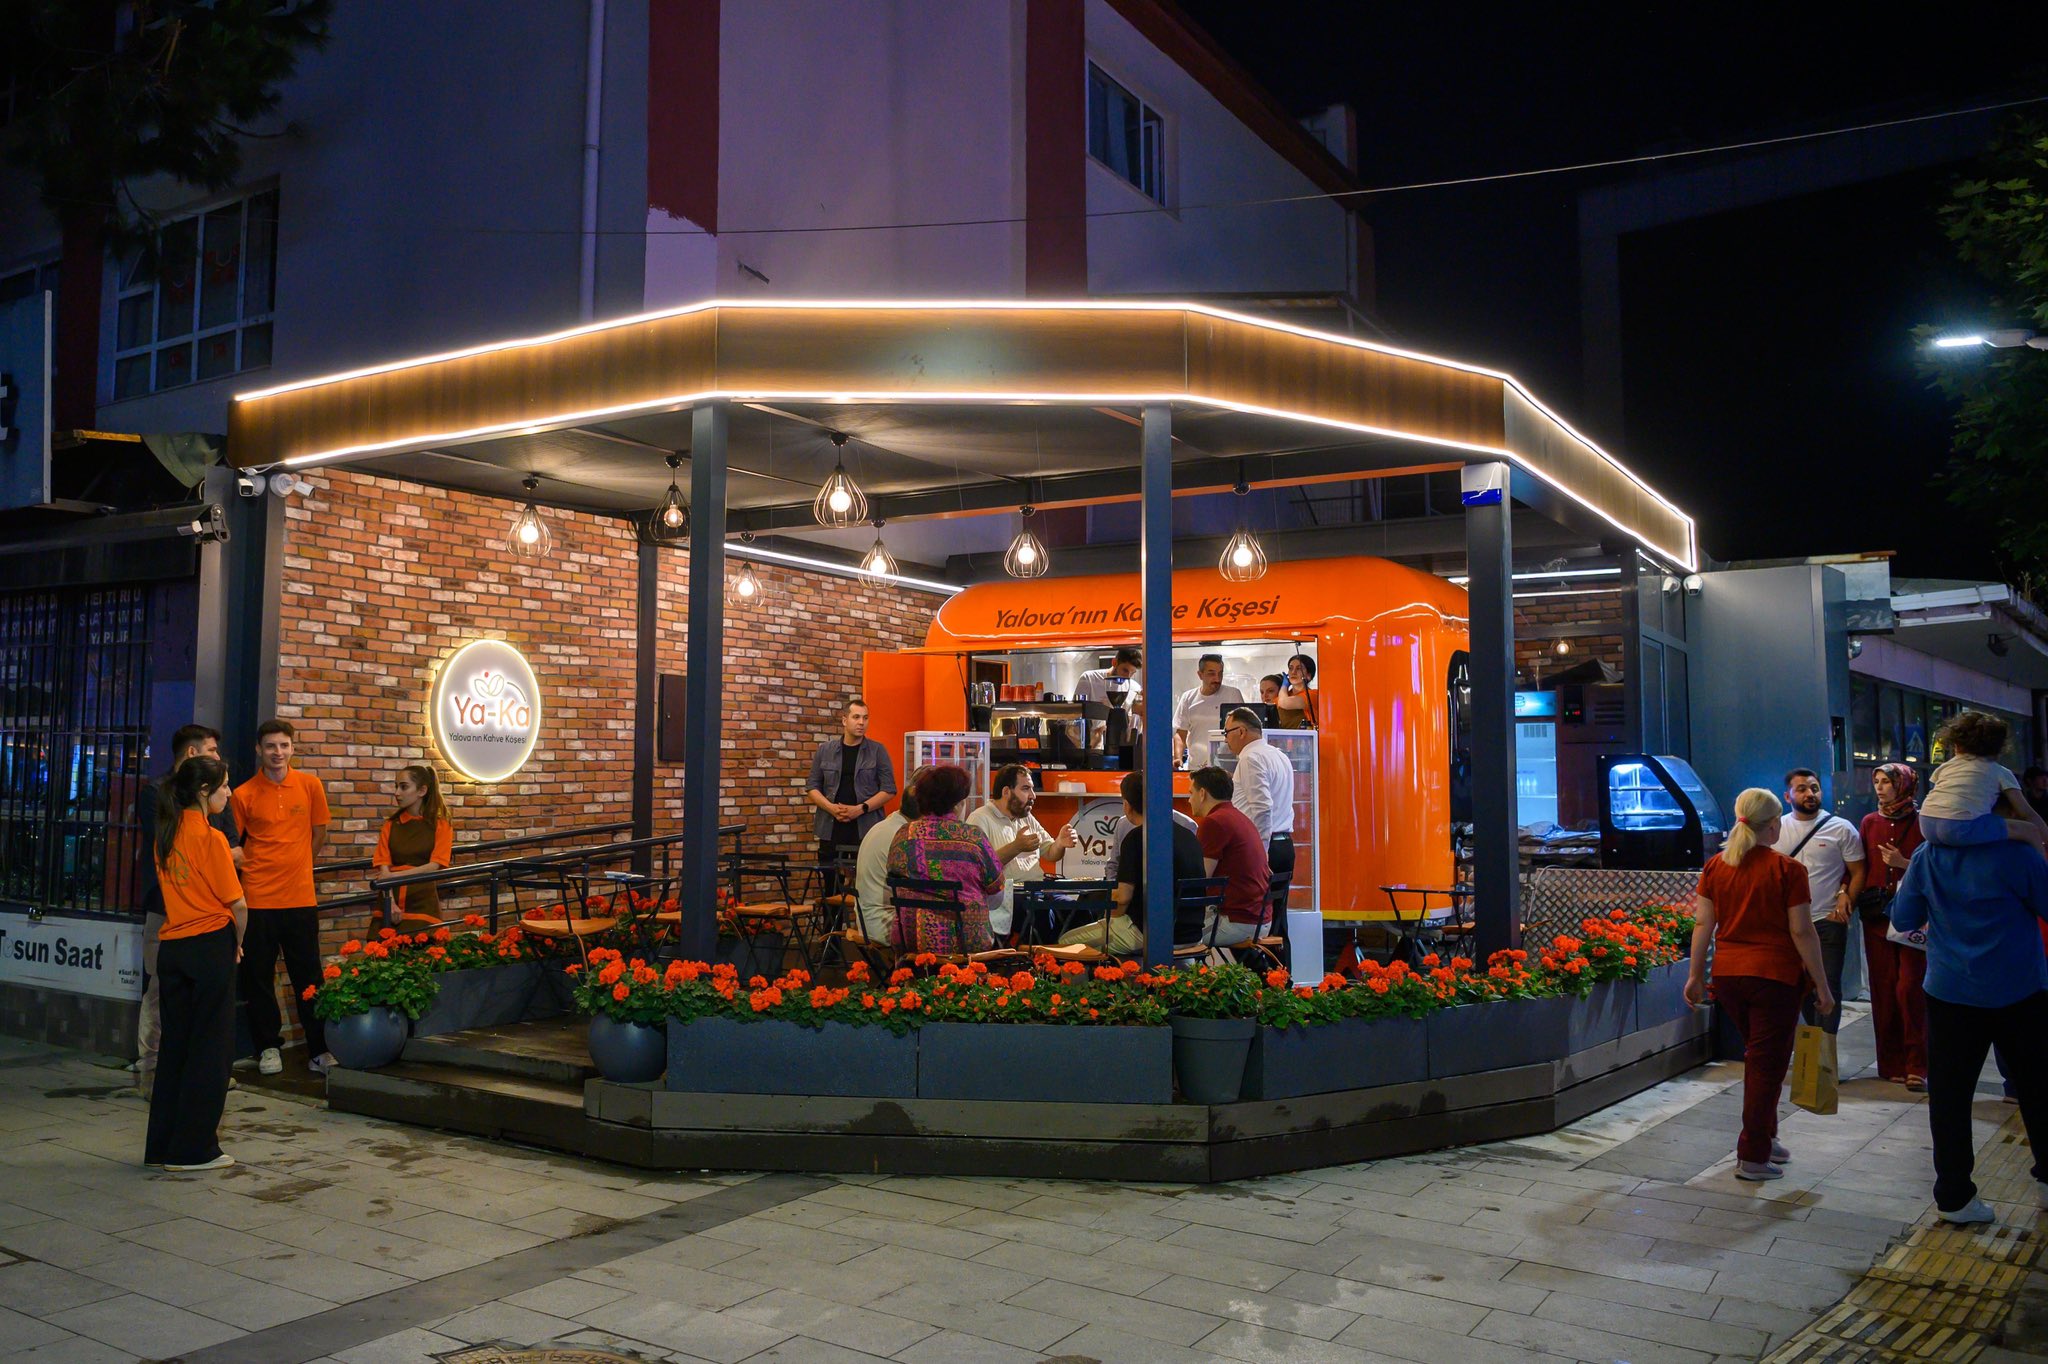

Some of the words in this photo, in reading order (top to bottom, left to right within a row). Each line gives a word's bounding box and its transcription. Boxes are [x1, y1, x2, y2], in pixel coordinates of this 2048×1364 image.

[996, 606, 1107, 628] Yalova'nın
[1113, 602, 1188, 622] Kae
[1197, 595, 1280, 623] Köşesi
[454, 696, 530, 727] Ya-Ka
[483, 733, 504, 743] Kahve
[1078, 835, 1113, 856] Ya-
[54, 937, 104, 970] Saat
